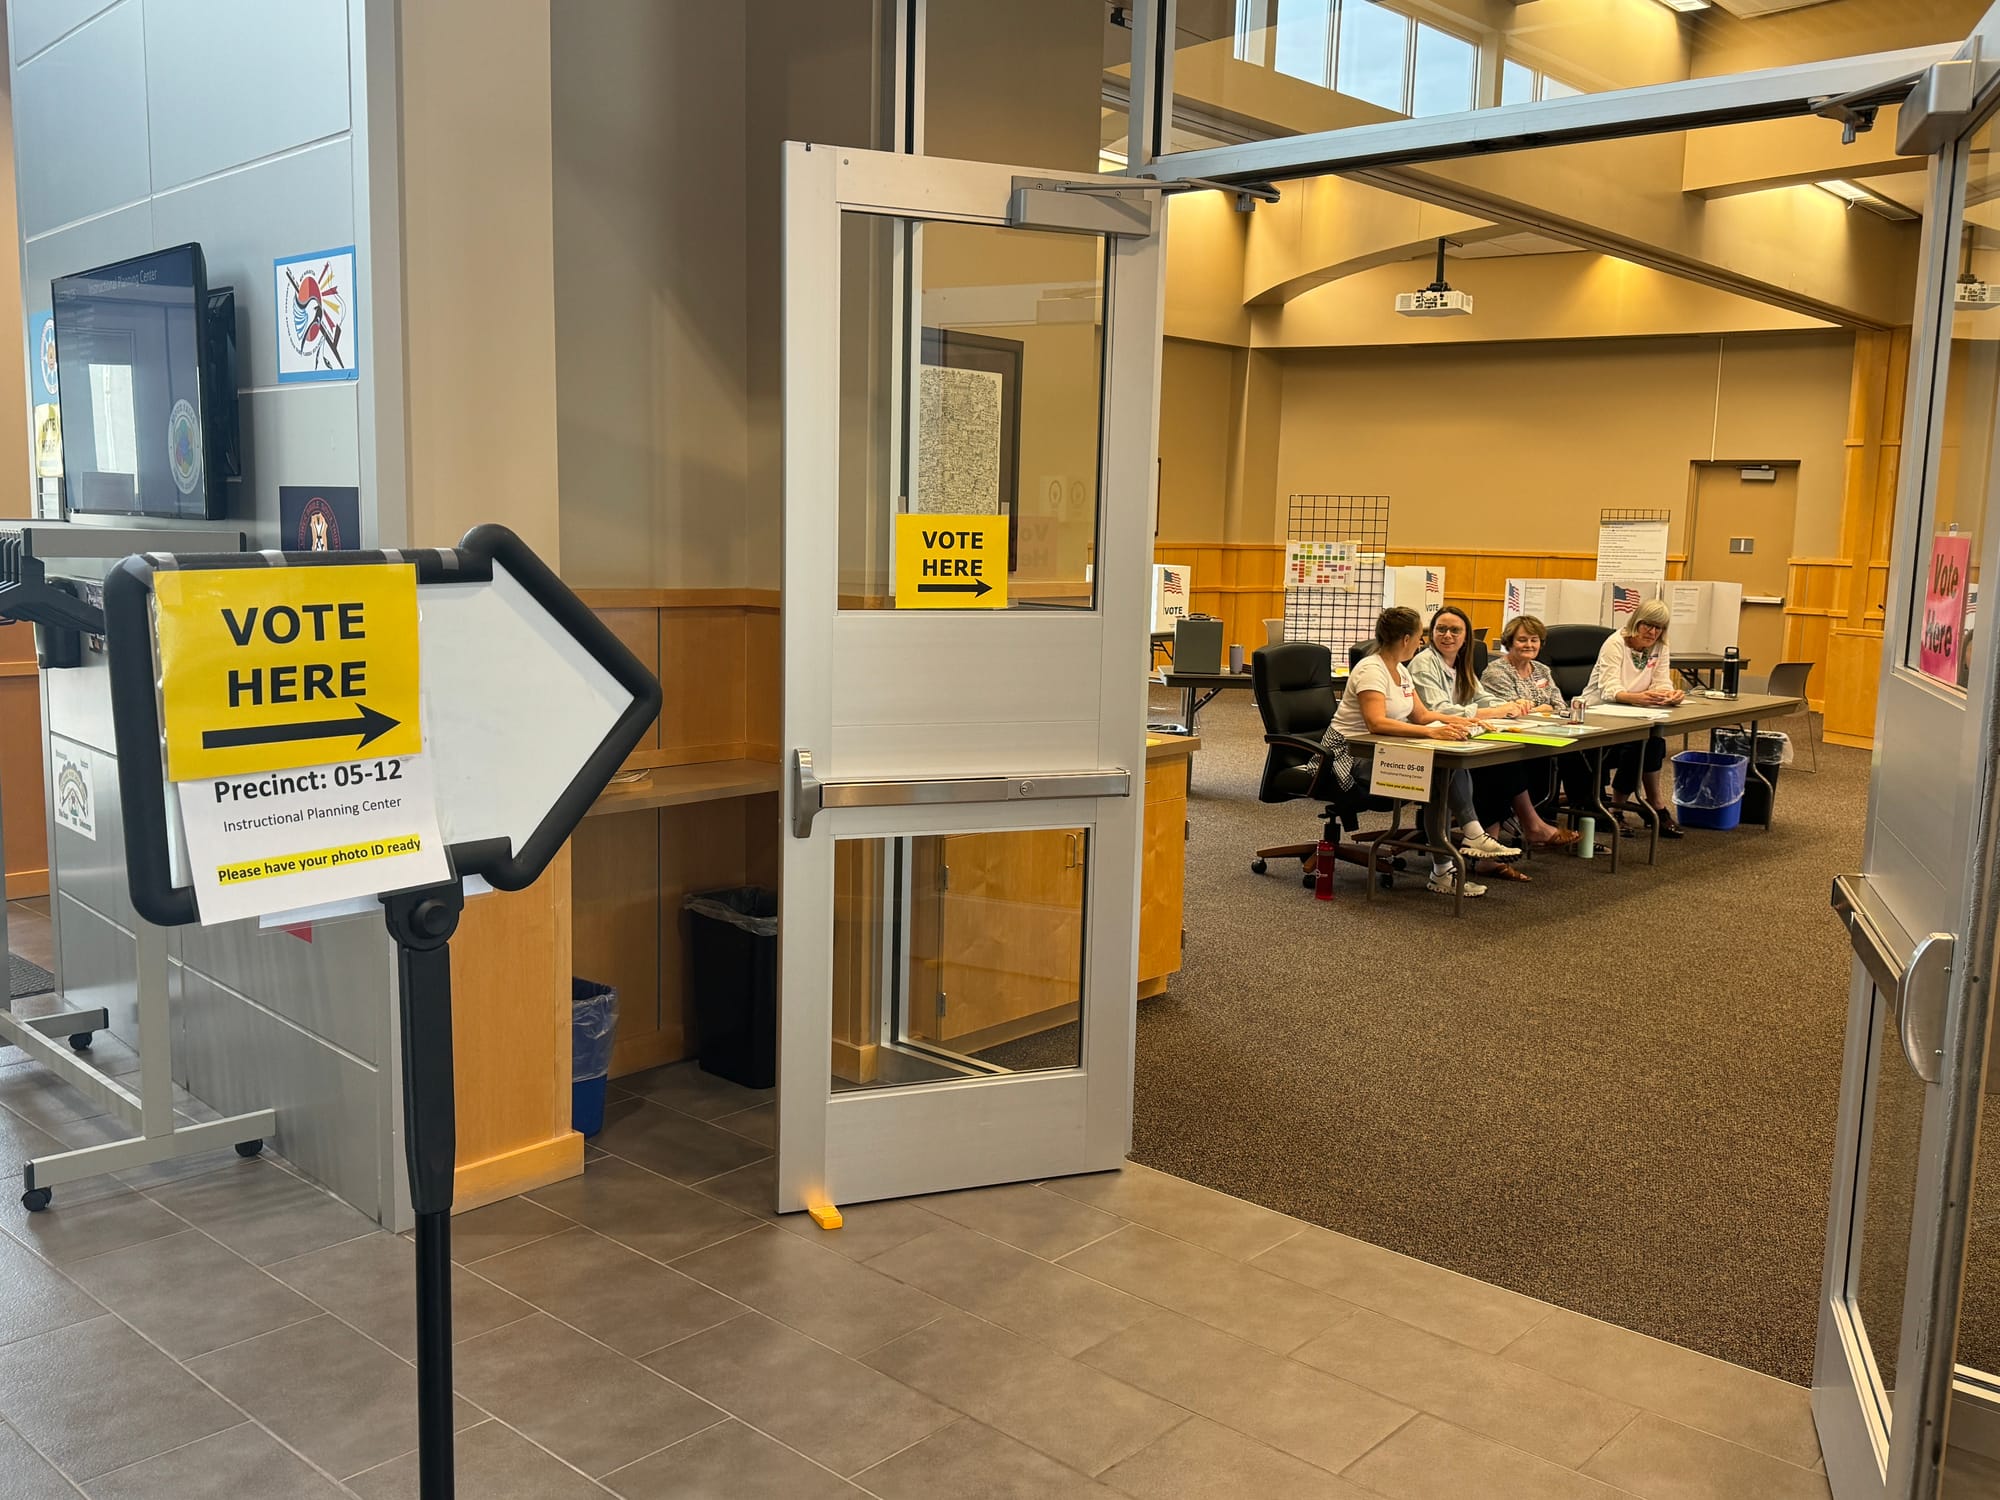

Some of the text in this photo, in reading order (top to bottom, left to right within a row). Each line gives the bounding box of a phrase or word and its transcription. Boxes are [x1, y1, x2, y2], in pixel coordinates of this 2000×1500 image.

[922, 531, 983, 549] VOTE
[922, 559, 983, 576] HERE
[1934, 554, 1958, 598] Vote
[221, 603, 365, 646] VOTE
[1164, 607, 1183, 615] VOTE
[1924, 609, 1952, 657] Here
[228, 661, 366, 708] HERE
[214, 759, 402, 803] Precinct: 05-12
[1381, 761, 1405, 770] Precinct:
[223, 798, 402, 832] Instructional Planning Center
[218, 838, 421, 882] Please have your photo ID ready
